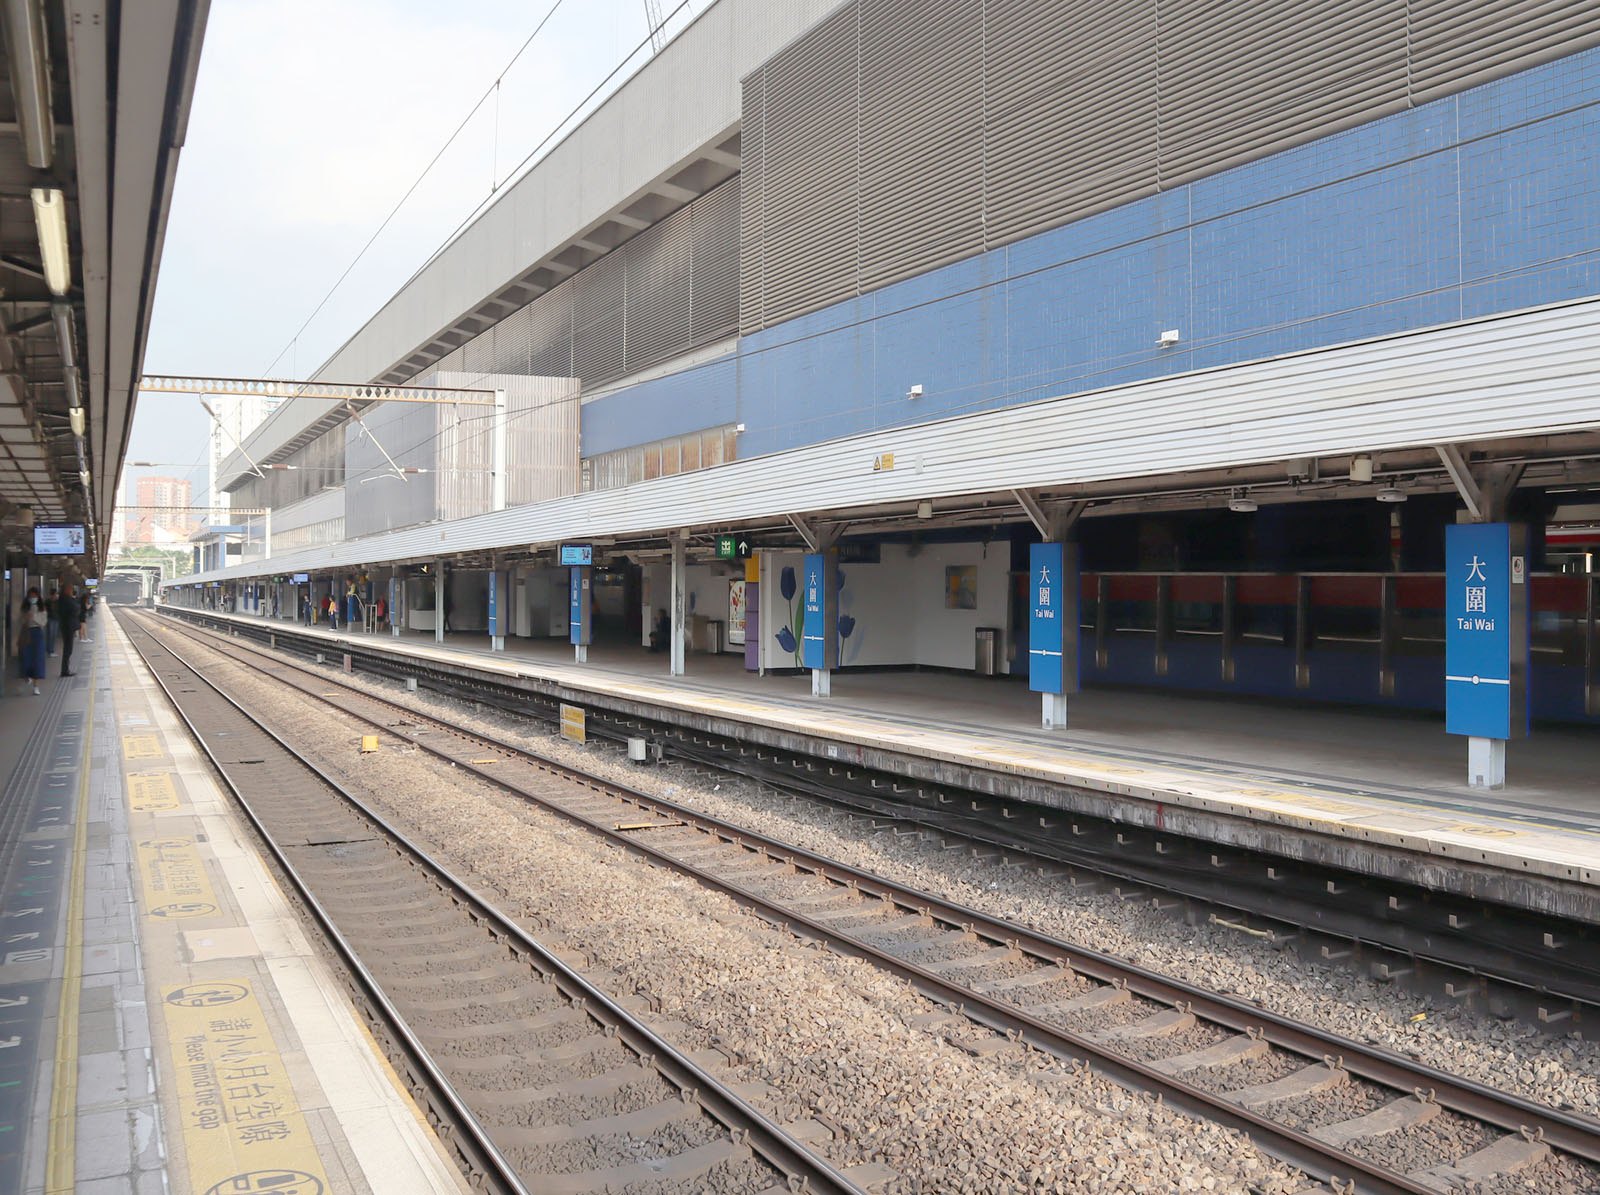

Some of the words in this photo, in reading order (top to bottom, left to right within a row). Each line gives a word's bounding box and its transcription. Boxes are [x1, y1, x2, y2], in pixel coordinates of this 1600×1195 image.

[1039, 565, 1050, 606] 大圍
[1465, 555, 1487, 613] 大圍
[1035, 609, 1044, 618] Tai
[1044, 609, 1055, 619] Wai
[1457, 618, 1473, 630] Tai
[1475, 618, 1495, 631] Wai
[183, 1034, 208, 1062] Please
[190, 1063, 216, 1087] mind
[208, 1018, 291, 1145] 請小心月台空隙
[194, 1088, 216, 1107] the
[191, 1107, 220, 1130] gap
